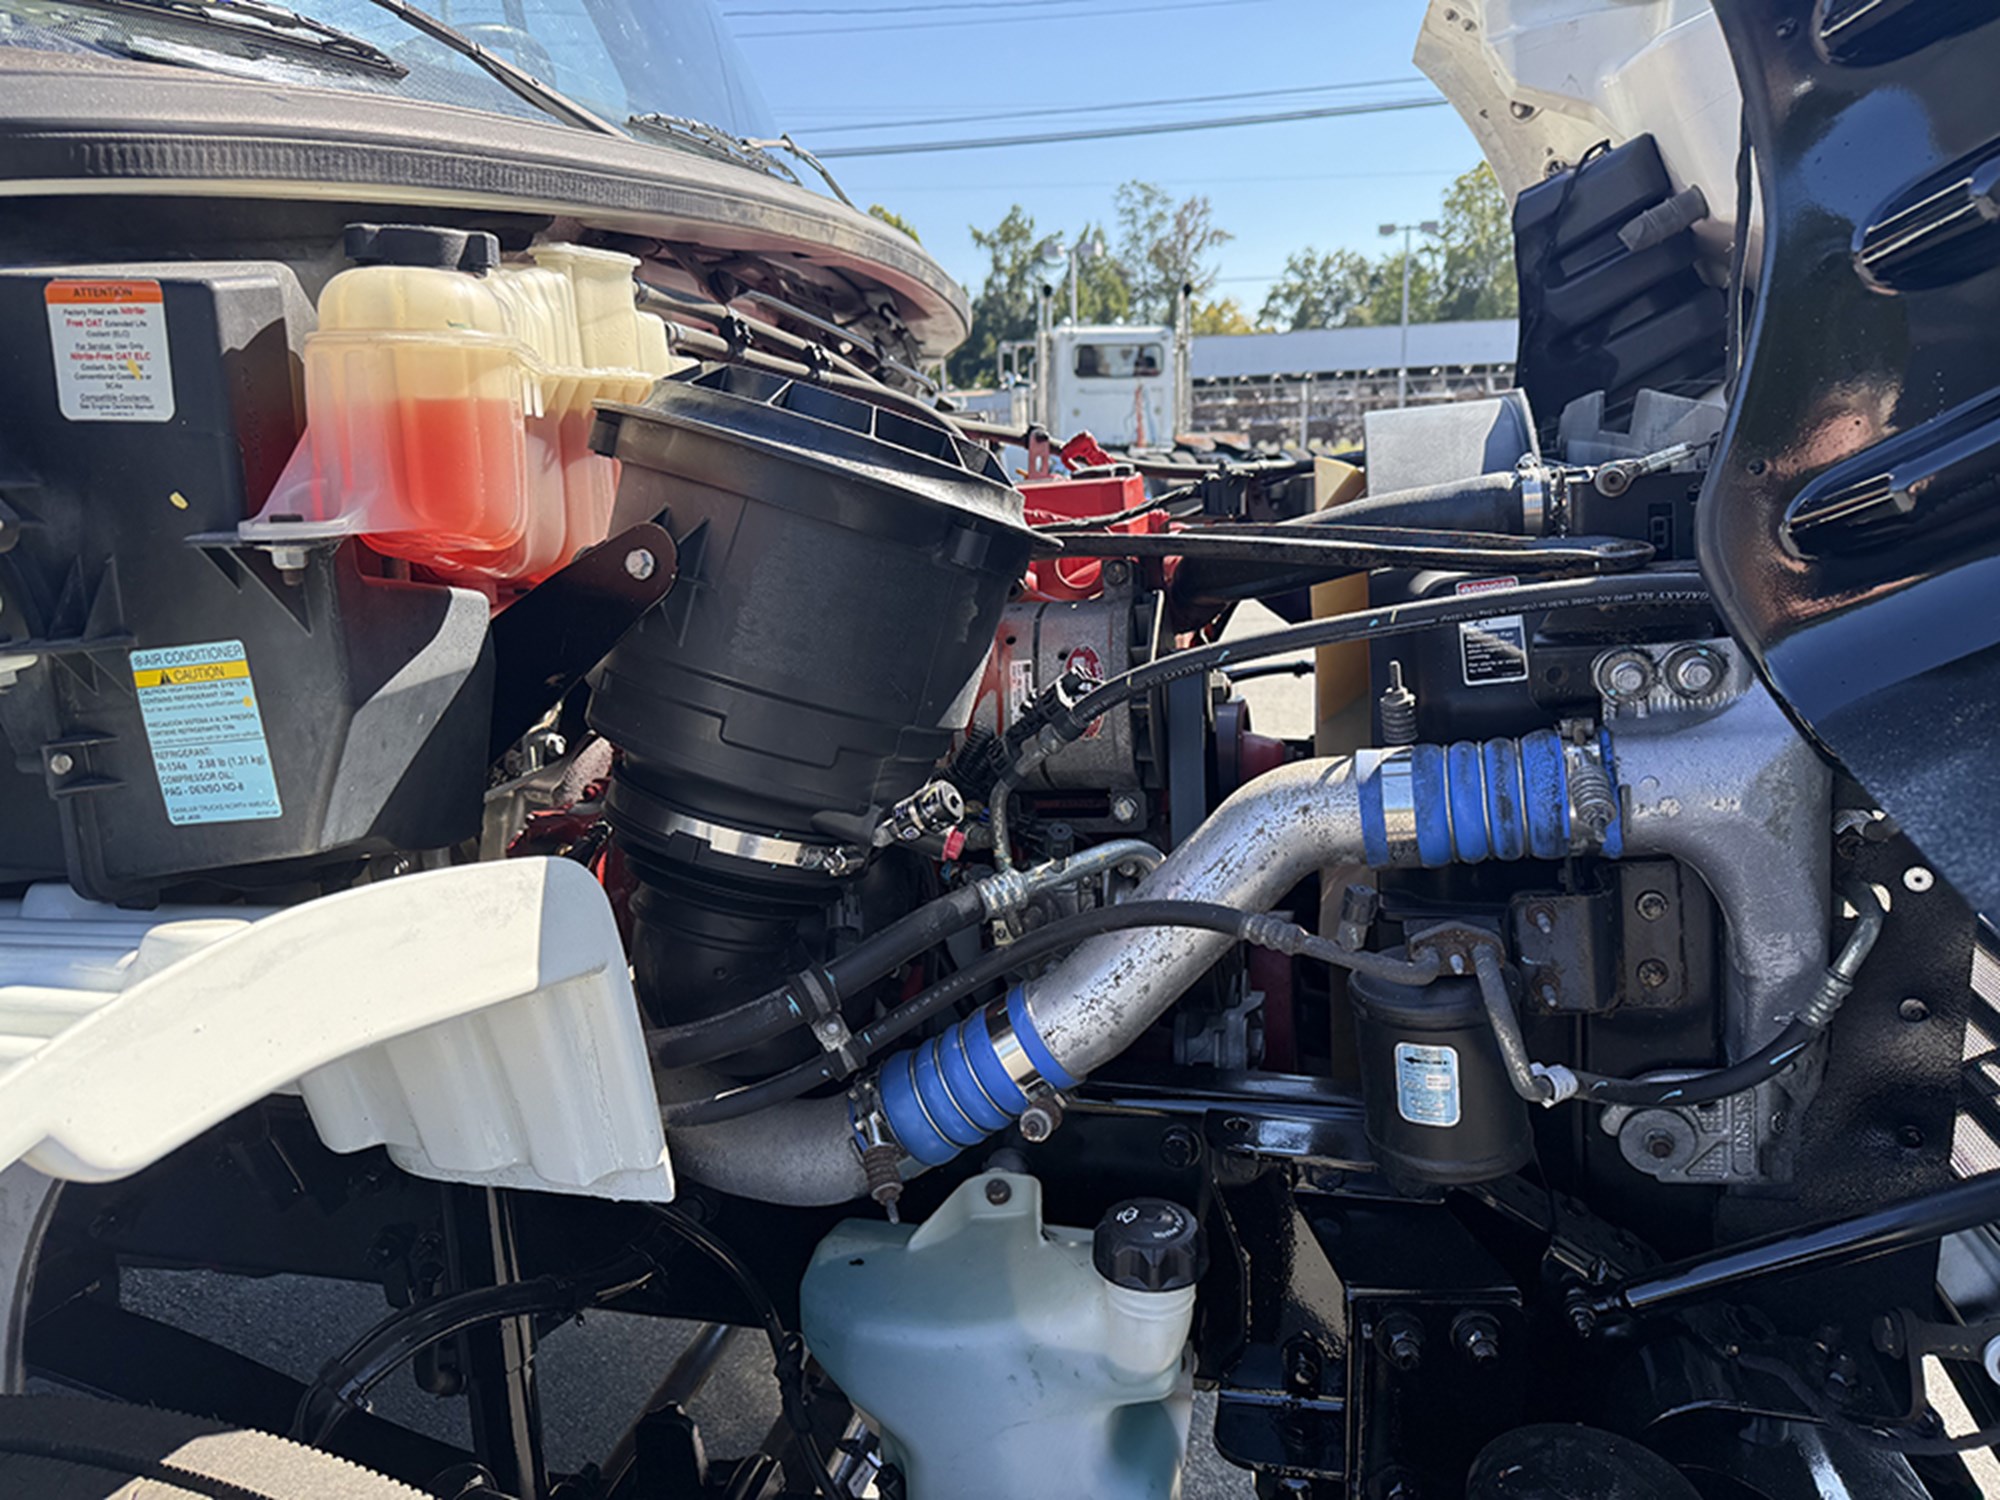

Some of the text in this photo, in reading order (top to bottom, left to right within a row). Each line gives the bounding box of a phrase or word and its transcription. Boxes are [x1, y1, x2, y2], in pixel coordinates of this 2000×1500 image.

[73, 287, 133, 297] ATTENTION
[63, 308, 86, 317] Factory
[66, 319, 84, 327] Free
[86, 318, 103, 327] OAT
[70, 351, 151, 361] Nitrite-Free OAT ELC
[145, 643, 244, 666] AIR CONDITIONER
[173, 665, 226, 681] CAUTION
[158, 761, 188, 772] R-134a
[218, 756, 226, 768] lb
[250, 753, 266, 766] kg)
[161, 771, 235, 785] COMPRESSOR OIL:
[164, 786, 184, 797] PAG
[189, 783, 222, 796] DENSO
